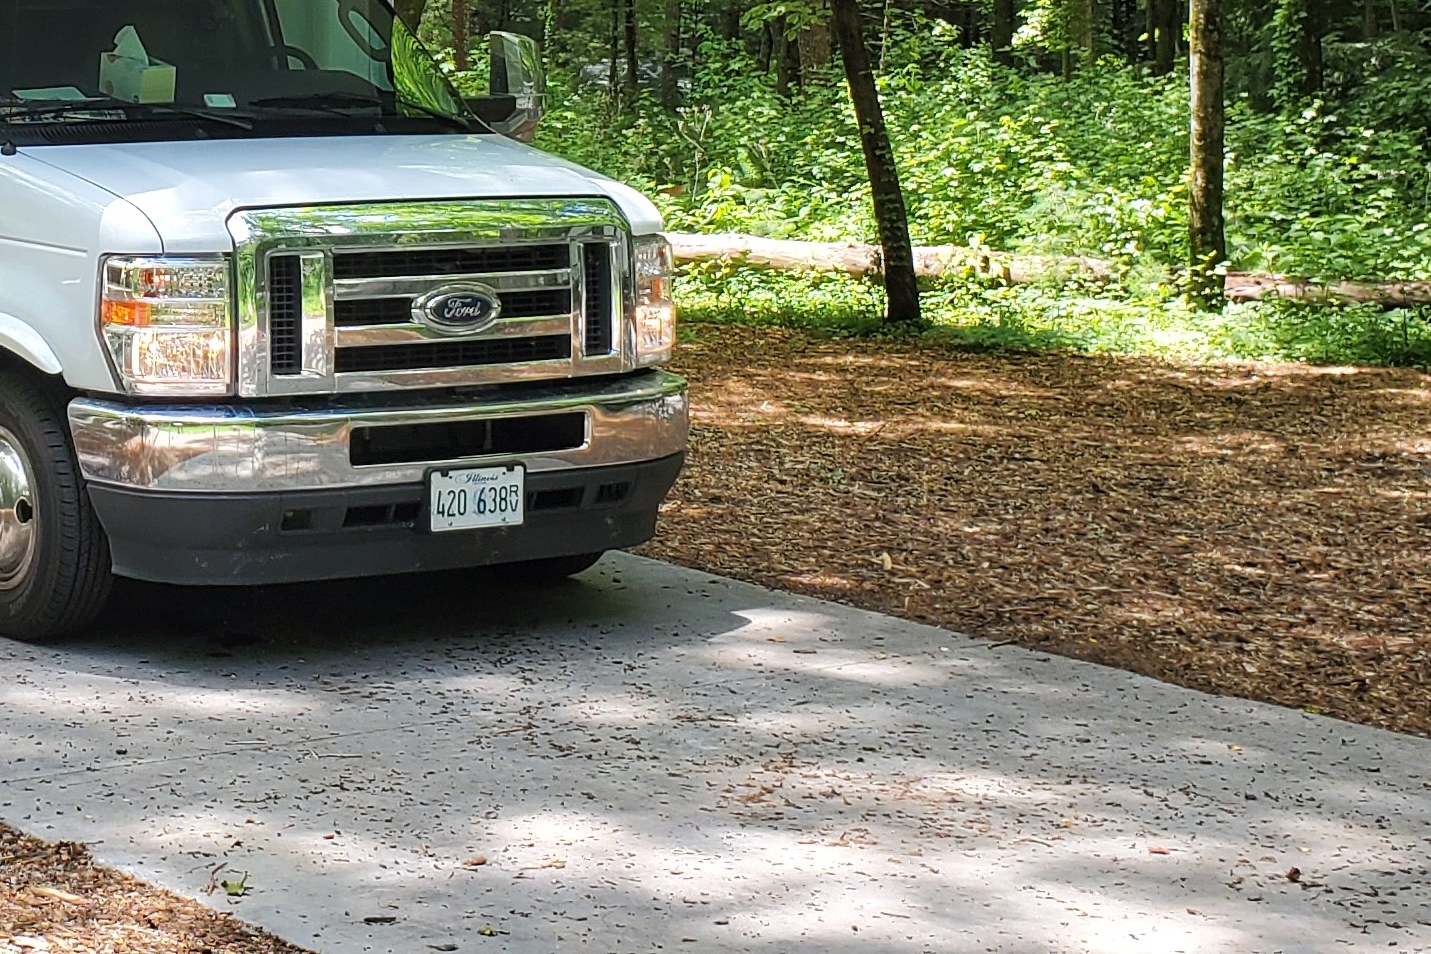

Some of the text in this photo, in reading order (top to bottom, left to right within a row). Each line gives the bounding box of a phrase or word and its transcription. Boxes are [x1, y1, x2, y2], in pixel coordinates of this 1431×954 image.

[444, 298, 481, 317] Ford
[465, 473, 499, 483] Illinois
[436, 489, 467, 517] 420
[477, 486, 508, 513] 638
